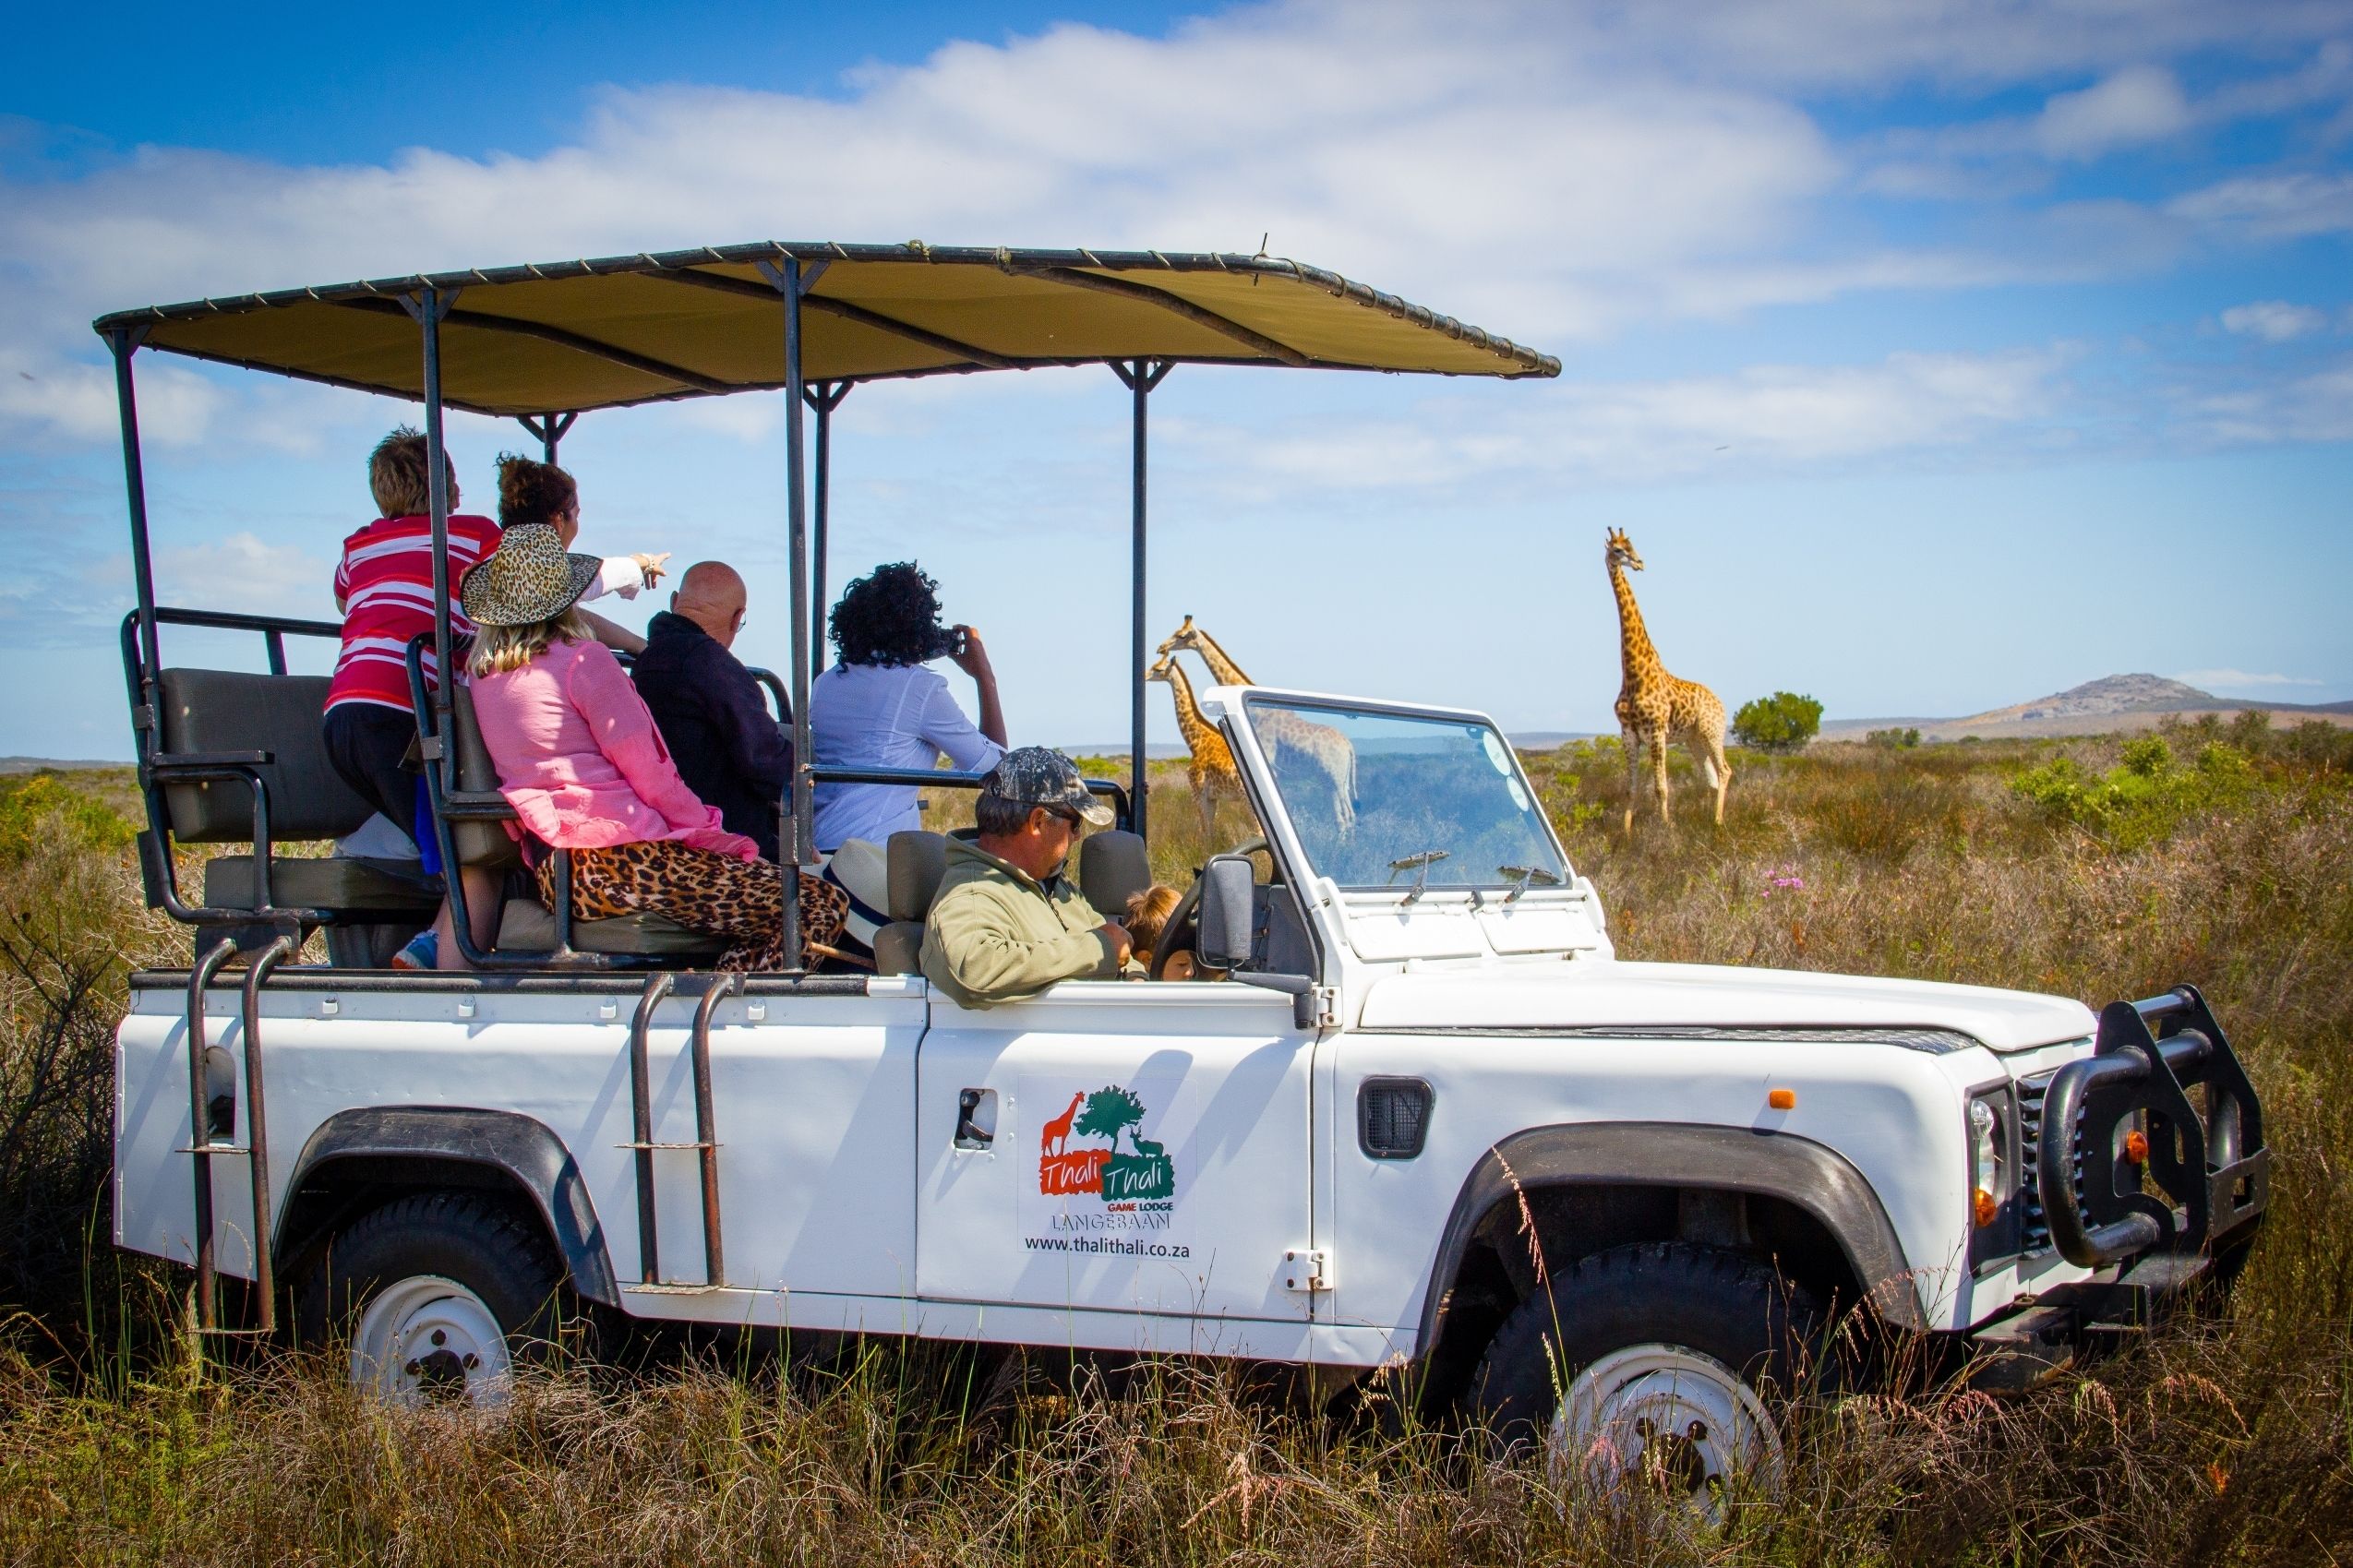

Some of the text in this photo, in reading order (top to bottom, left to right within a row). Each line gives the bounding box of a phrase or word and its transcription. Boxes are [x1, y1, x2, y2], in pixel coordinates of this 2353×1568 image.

[1044, 1156, 1161, 1195] Thali Thali
[1108, 1202, 1173, 1212] GAME LODGE
[1050, 1213, 1170, 1231] LANGEBAAN
[1026, 1237, 1190, 1258] www.thalithali.co.za
